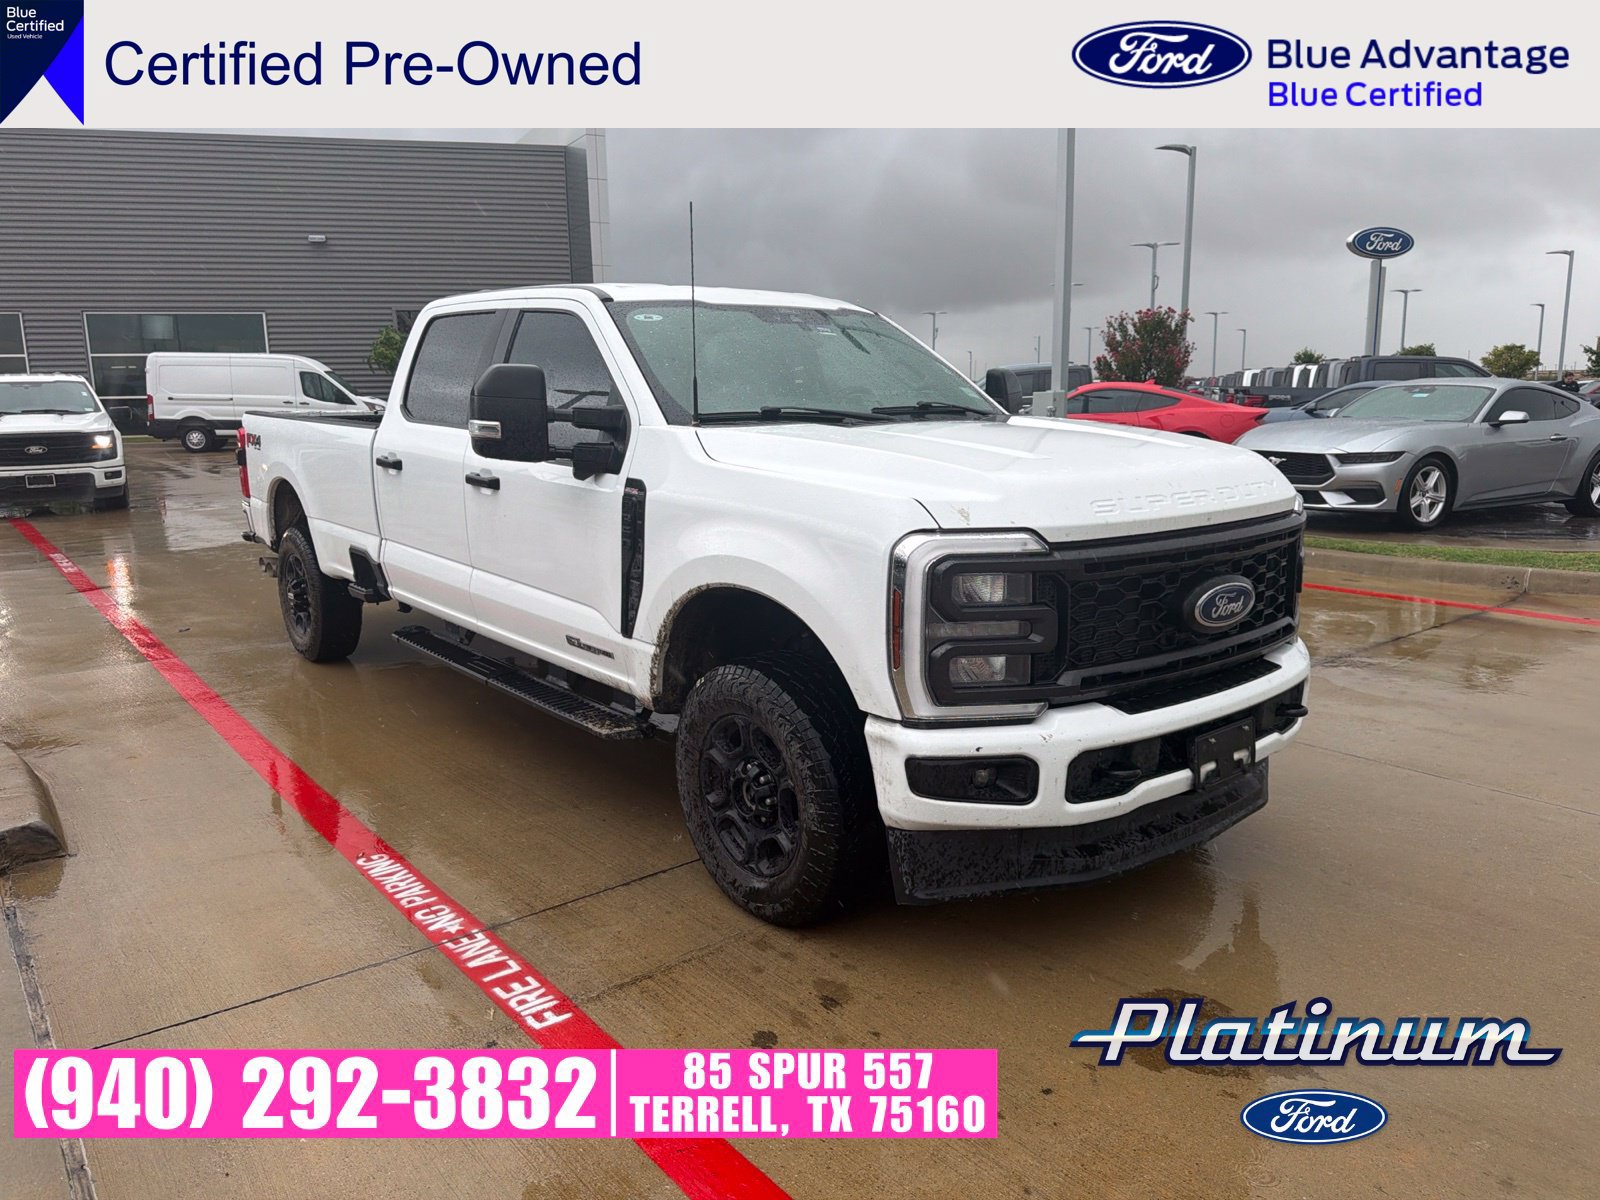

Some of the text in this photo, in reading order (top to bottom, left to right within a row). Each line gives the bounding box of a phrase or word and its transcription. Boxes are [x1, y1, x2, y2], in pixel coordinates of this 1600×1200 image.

[1365, 232, 1403, 251] Ford
[1211, 591, 1245, 618] Ford
[356, 853, 438, 909] PARKING
[441, 928, 522, 983] LANE
[491, 975, 573, 1031] FIRE
